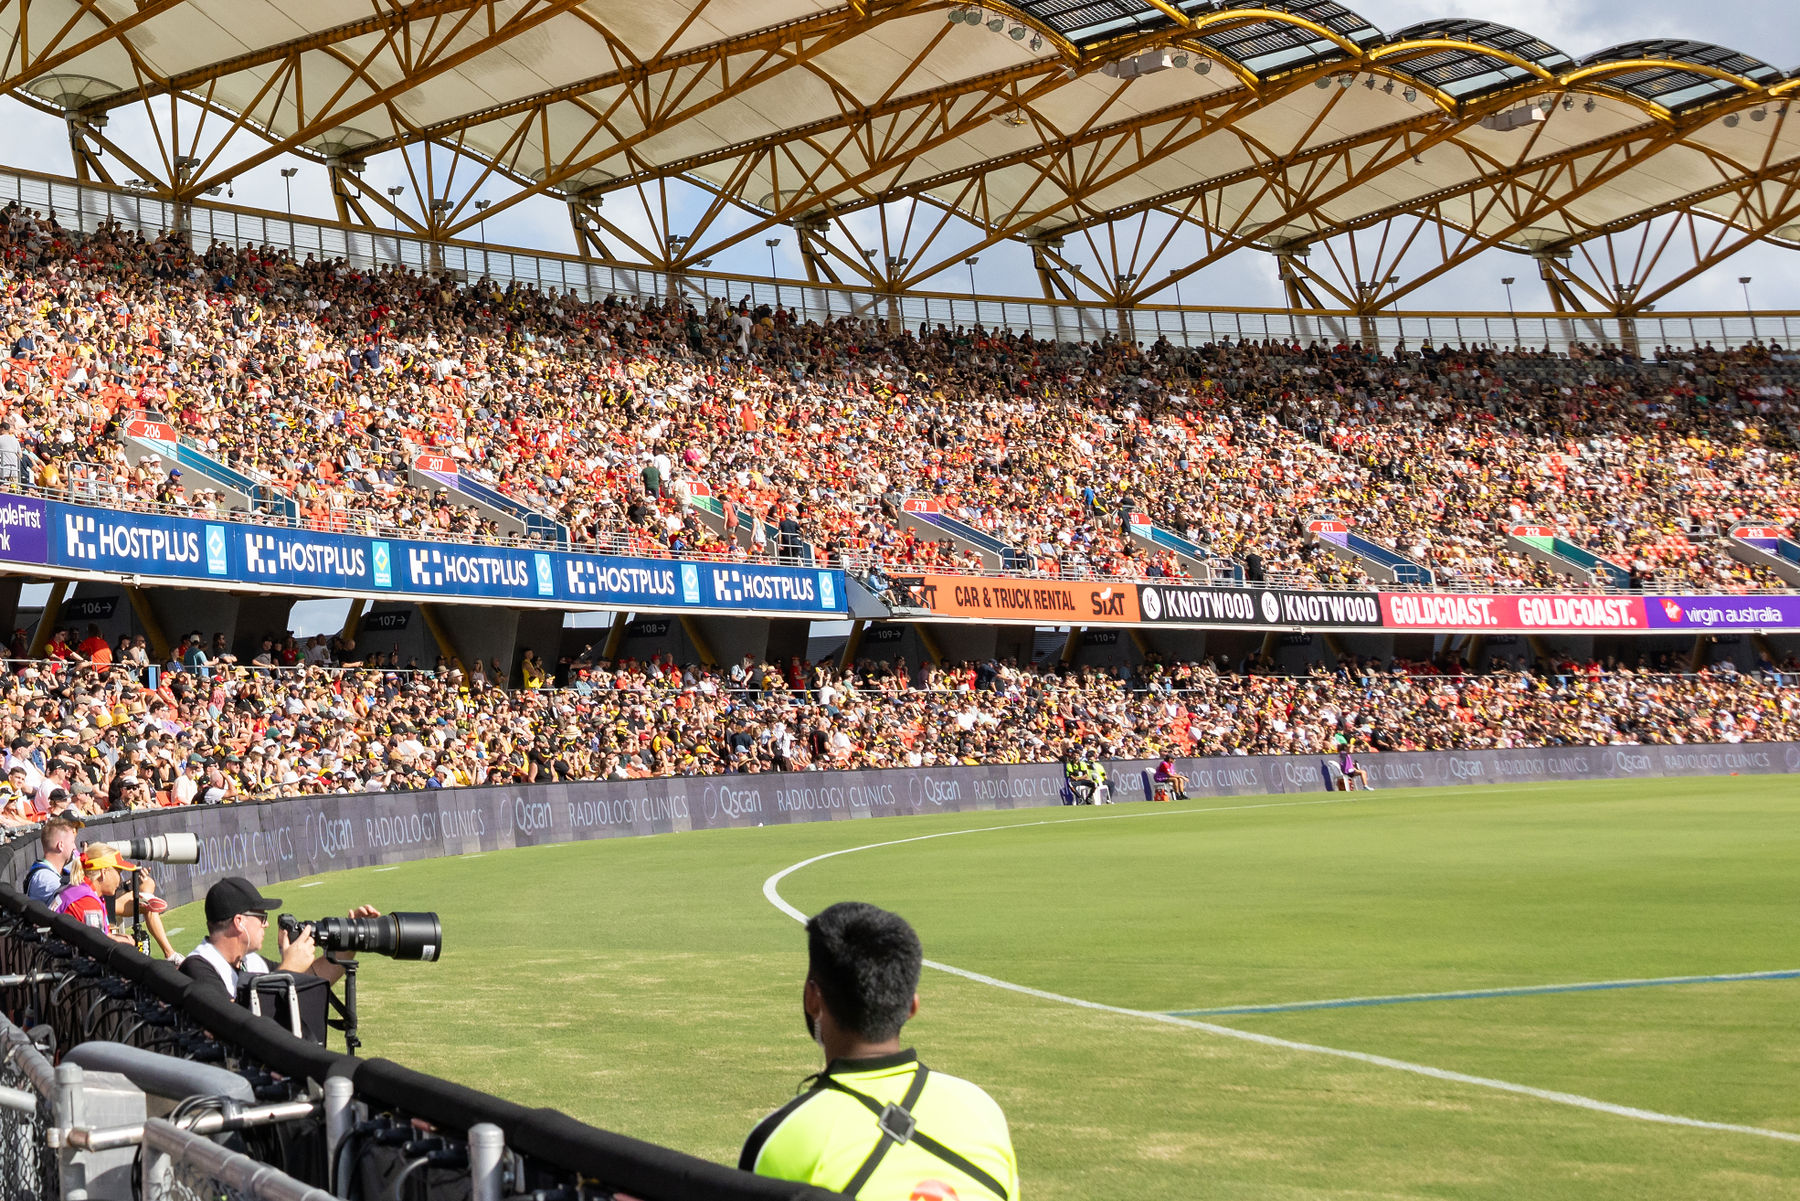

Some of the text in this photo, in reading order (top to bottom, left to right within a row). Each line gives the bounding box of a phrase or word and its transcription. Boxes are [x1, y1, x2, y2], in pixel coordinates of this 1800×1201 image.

[143, 423, 161, 438] 206
[429, 457, 444, 471] 207
[1320, 522, 1334, 532] 211
[1524, 527, 1540, 536] 212
[99, 523, 200, 563] HOSTPLUS
[278, 541, 366, 577] HOSTPLUS
[443, 555, 528, 586] HOSTPLUS
[598, 566, 676, 595] HOSTPLUS
[742, 577, 815, 602] HOSTPLUS
[81, 602, 102, 614] 106
[955, 585, 1075, 611] CAR & TRUCK RENTAL
[1165, 590, 1254, 620] KNOTWOOD
[1283, 594, 1378, 623] KNOTWOOD
[379, 615, 397, 626] 107
[641, 623, 658, 634] 108
[1685, 606, 1783, 626] virgin australia
[1284, 761, 1319, 785] Qscan
[1384, 762, 1424, 781] CLINICS
[1450, 756, 1590, 780] Qscan RADIOLOGY CLINICS
[1616, 751, 1770, 773] Qscan RADIOLOGY CLINICS
[923, 776, 961, 802] Qscan
[974, 776, 1038, 799] RADIOLOGY
[1216, 767, 1258, 787] CLINICS
[720, 783, 896, 819] Qscan RADIOLOGY CLINICS
[515, 795, 689, 836] Qscan RADIOLOGY CLINICS
[252, 826, 294, 866] CLINICS
[318, 808, 485, 859] Qscan RADIOLOGY CLINICS
